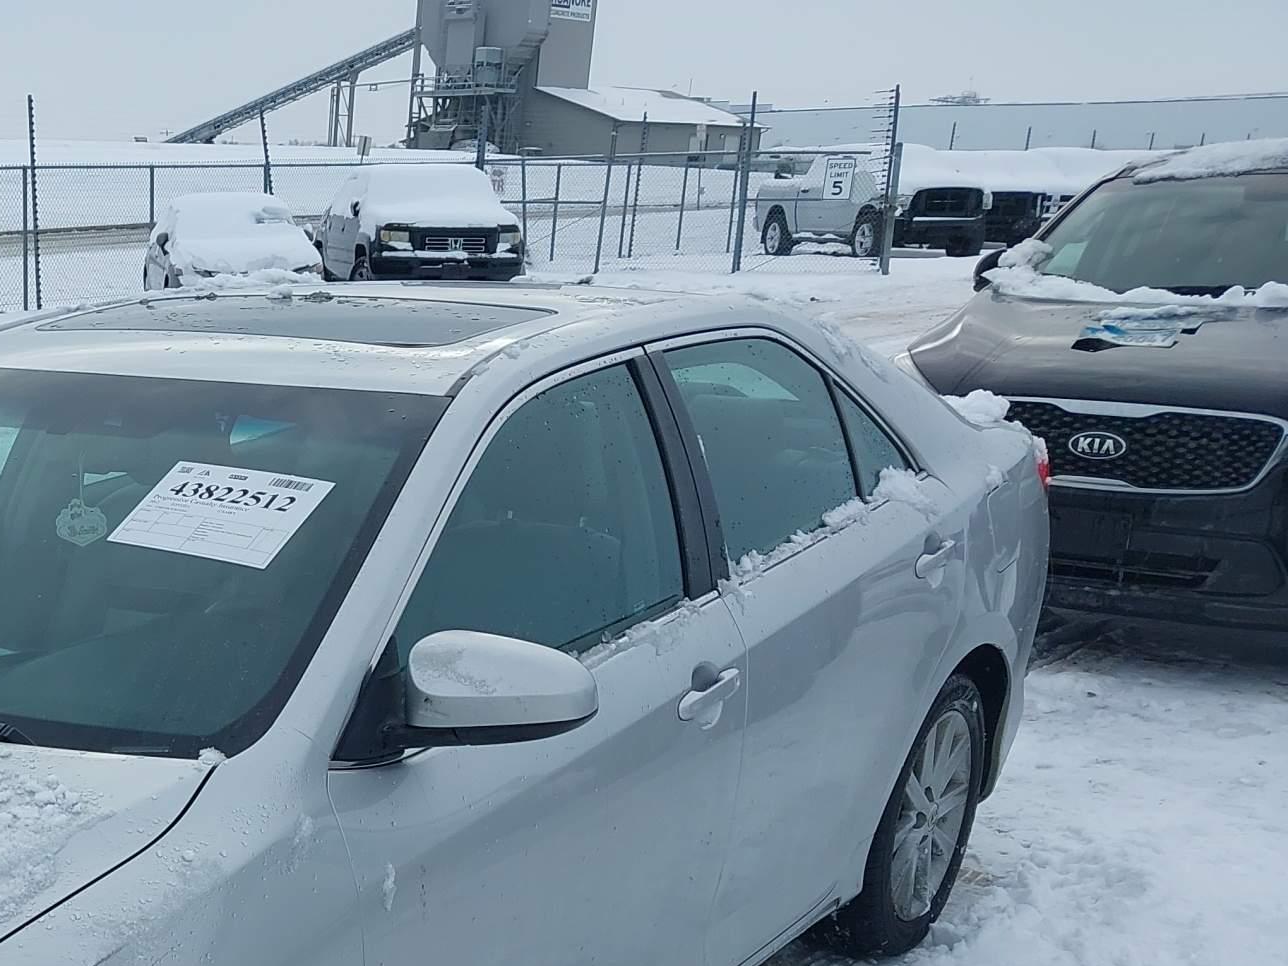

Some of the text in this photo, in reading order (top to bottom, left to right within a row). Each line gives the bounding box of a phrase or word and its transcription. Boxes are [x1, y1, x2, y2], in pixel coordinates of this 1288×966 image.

[831, 181, 843, 195] 5
[1077, 436, 1116, 455] KIA
[169, 481, 296, 512] 43822512
